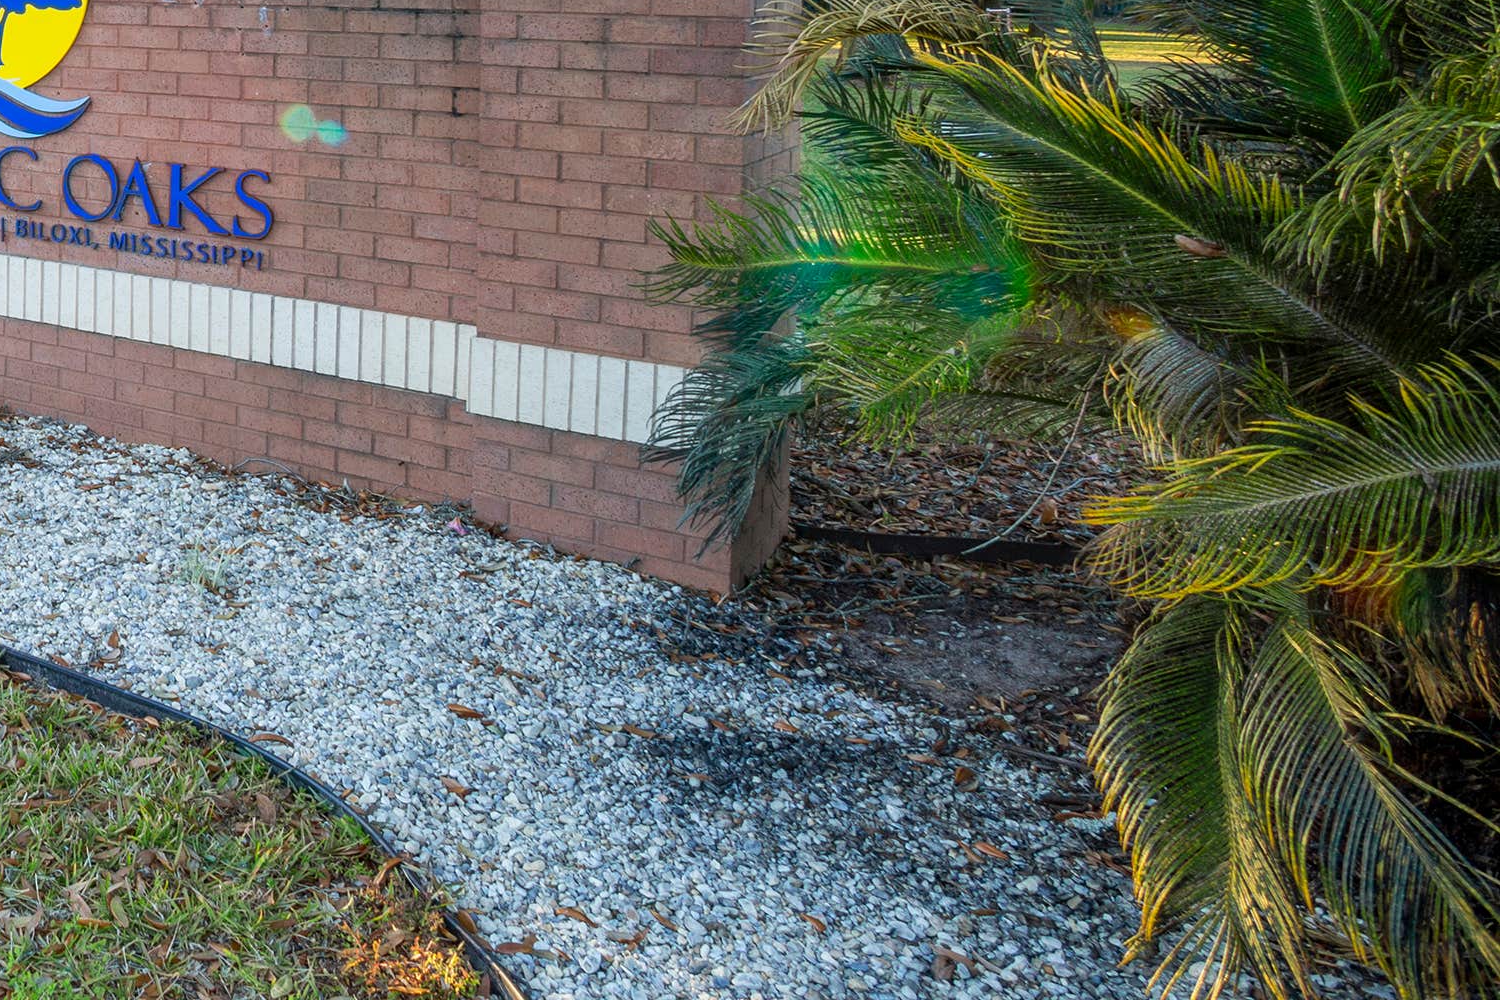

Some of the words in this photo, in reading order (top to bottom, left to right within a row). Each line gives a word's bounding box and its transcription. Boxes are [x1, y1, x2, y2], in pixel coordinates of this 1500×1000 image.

[62, 153, 274, 240] OAKS
[15, 218, 100, 250] BILOXI,
[108, 231, 265, 272] MISSISSIPPI
